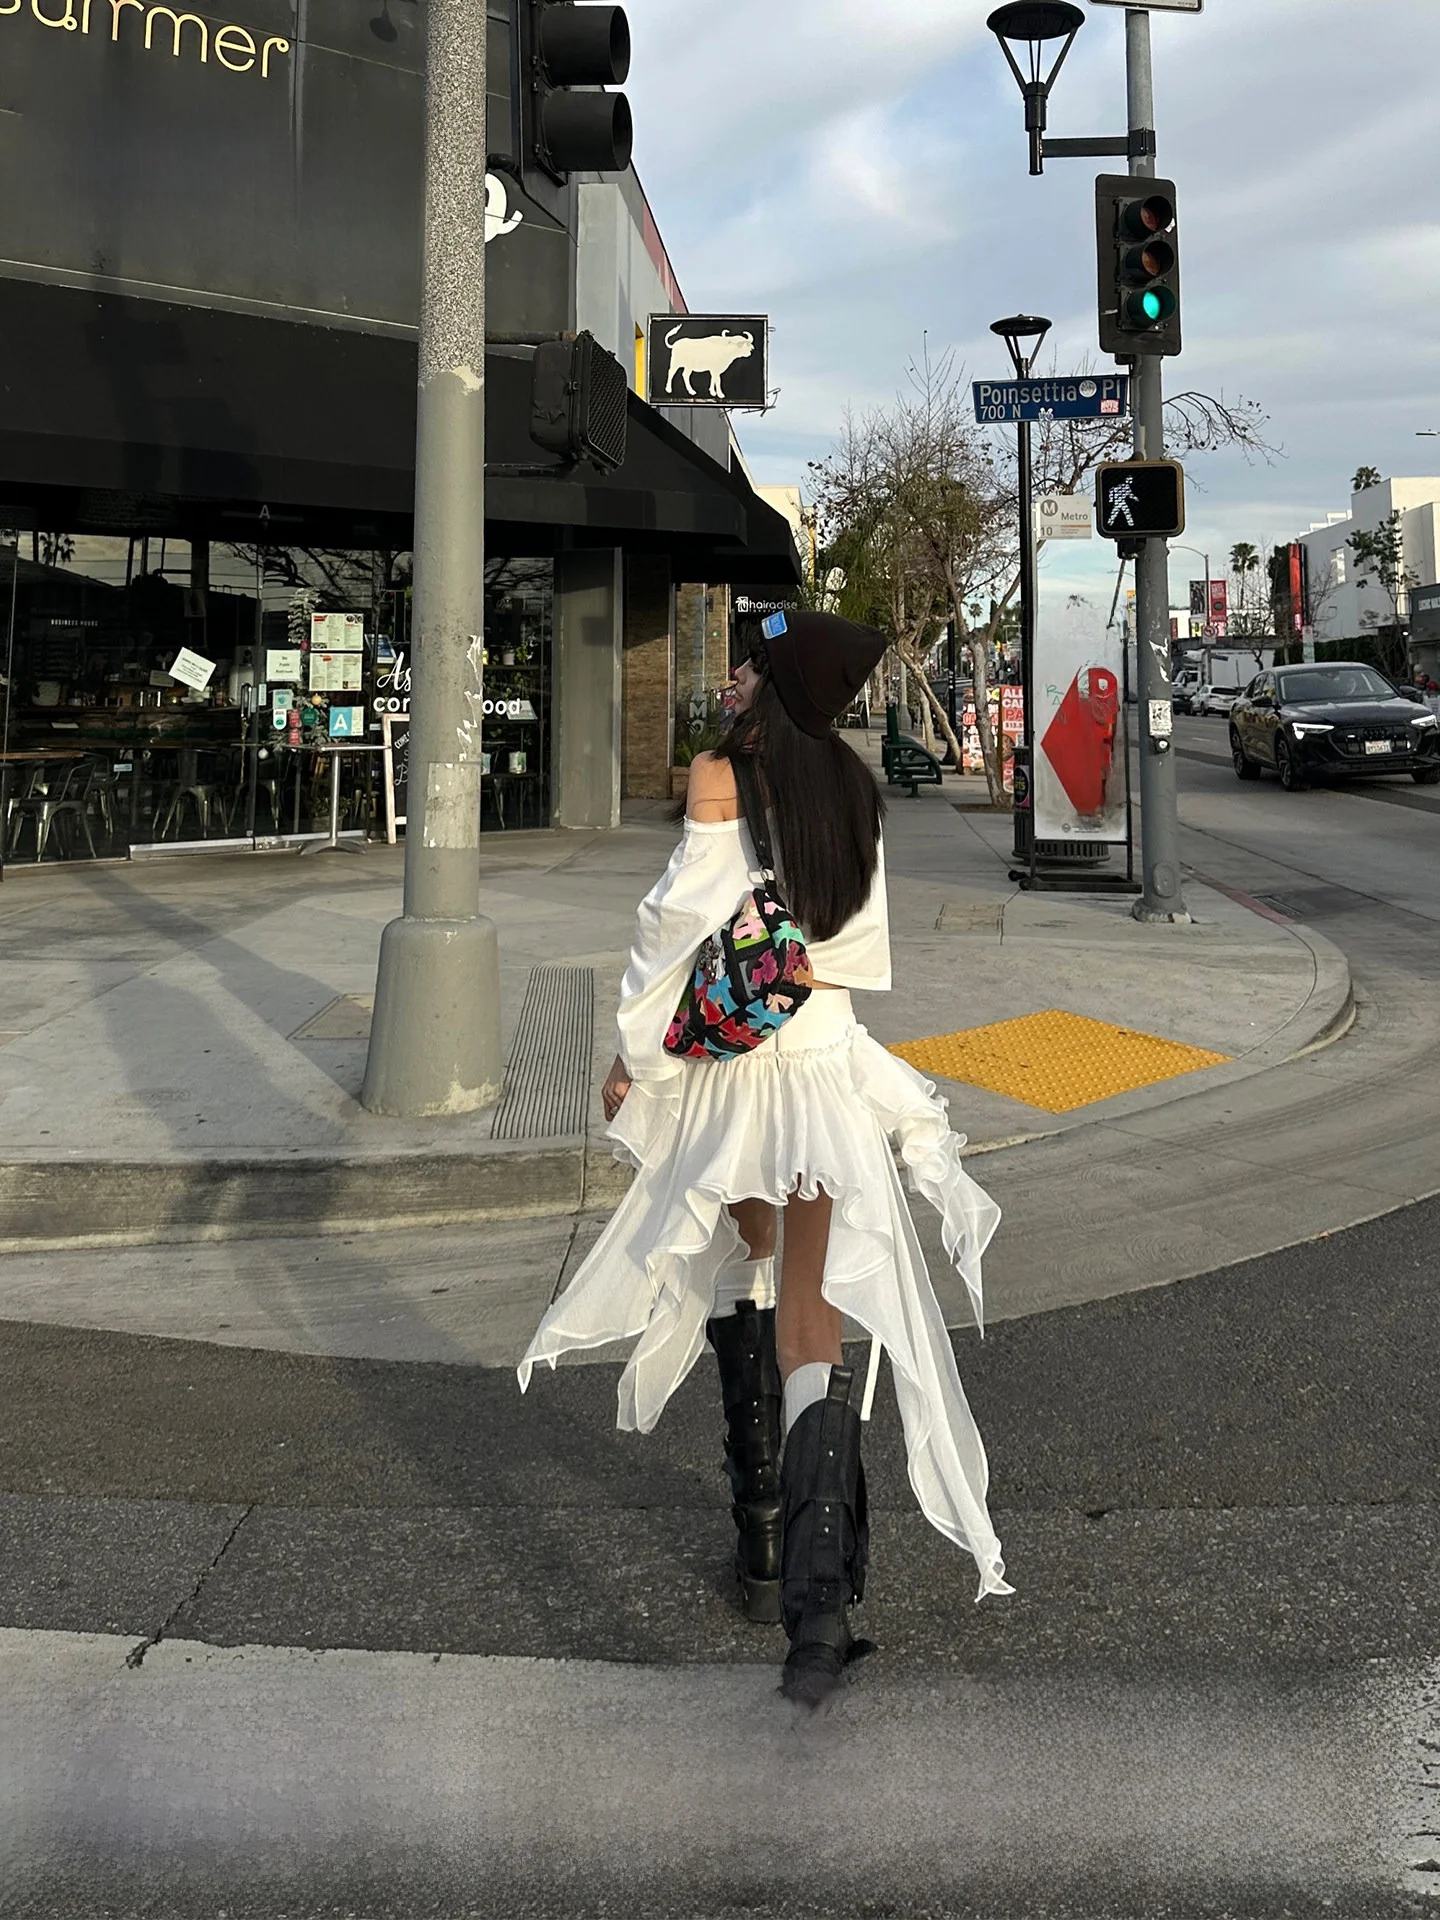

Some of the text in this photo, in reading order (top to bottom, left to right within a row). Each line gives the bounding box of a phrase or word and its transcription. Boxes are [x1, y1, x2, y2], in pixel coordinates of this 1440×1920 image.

[979, 382, 1078, 405] Poinsettia
[1102, 378, 1121, 399] Pl
[980, 404, 1021, 420] 700 N
[1061, 512, 1088, 521] Metro
[1041, 526, 1053, 537] 10
[749, 600, 798, 609] hairadise
[333, 713, 348, 730] A
